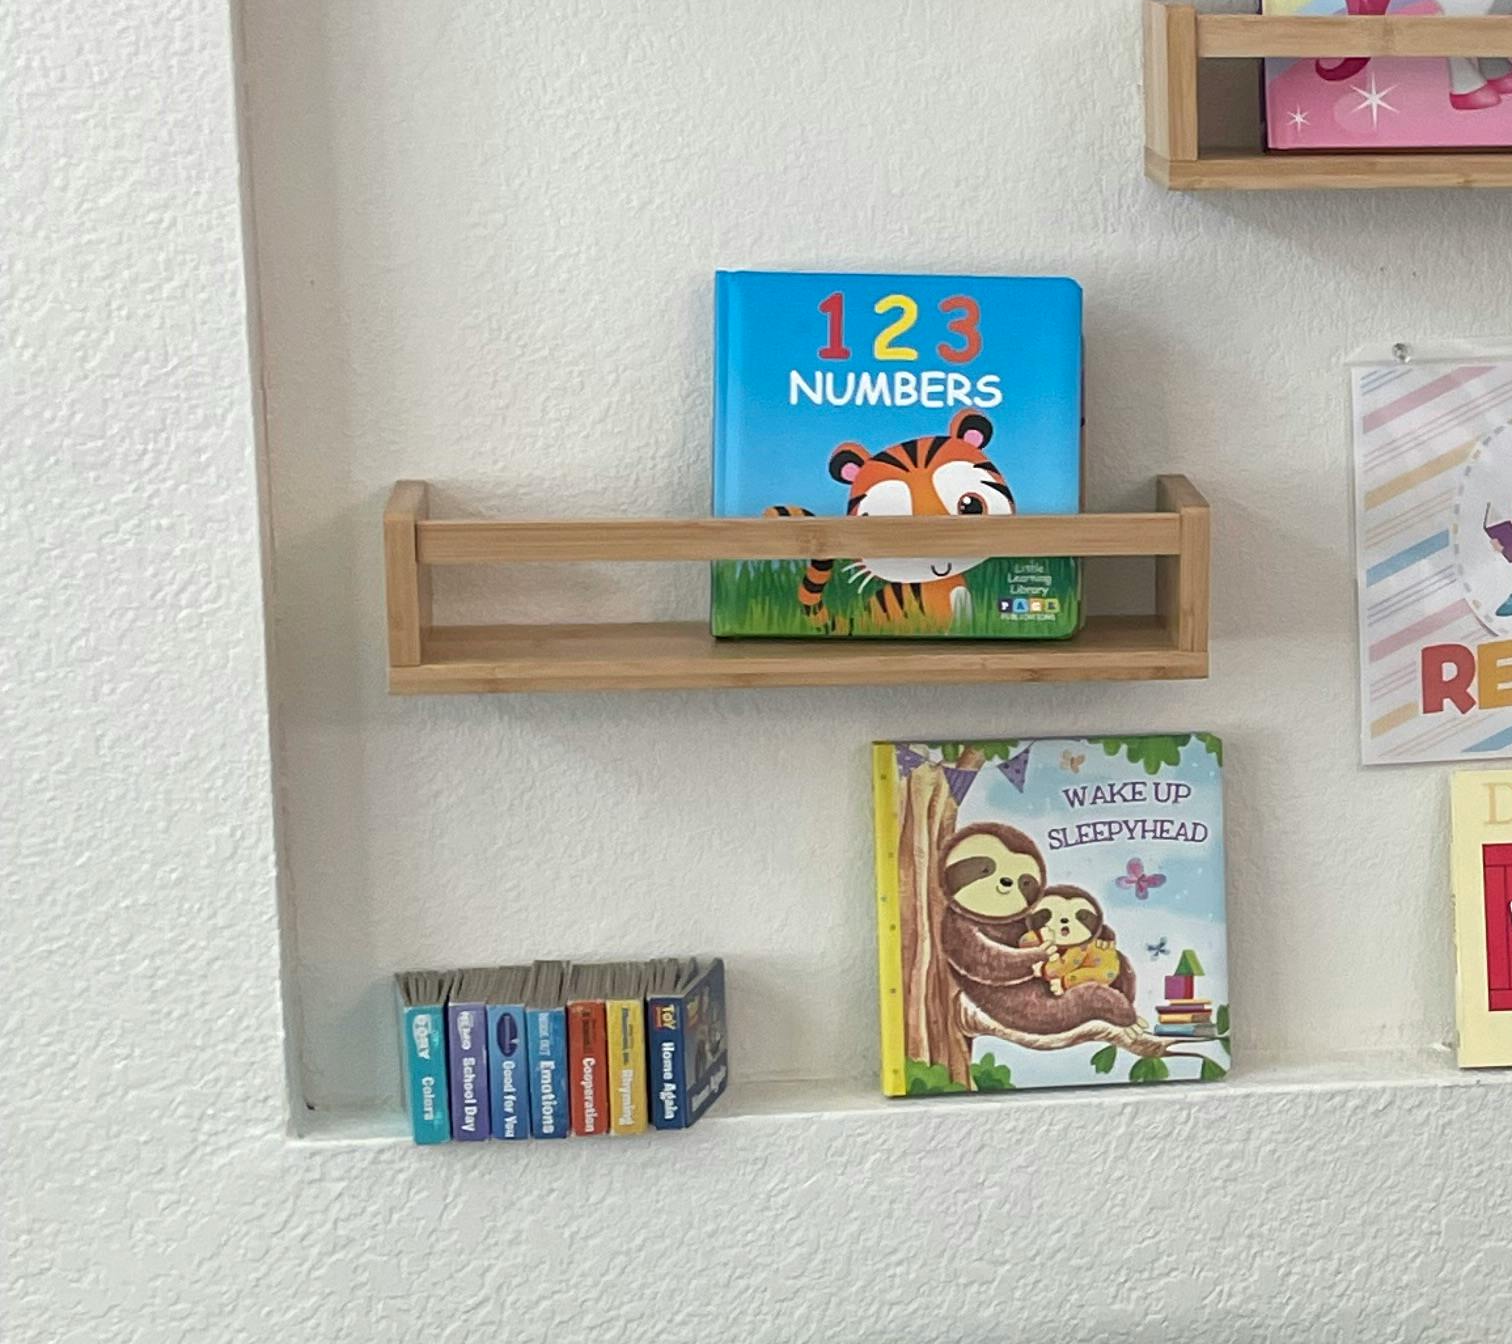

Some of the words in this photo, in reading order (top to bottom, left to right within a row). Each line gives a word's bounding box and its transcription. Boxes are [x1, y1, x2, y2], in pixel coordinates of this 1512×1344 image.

[817, 292, 851, 360] 1
[873, 294, 918, 361] 2
[936, 295, 983, 364] 3
[789, 370, 1003, 408] NUMBERS
[1062, 782, 1147, 809] WAKE
[1153, 782, 1192, 805] UP
[1048, 819, 1209, 850] SLEEPYHEAD
[462, 1057, 477, 1104] School
[502, 1061, 516, 1093] Good
[661, 1042, 676, 1081] Home
[421, 1076, 436, 1121] Colors
[503, 1093, 518, 1113] for
[539, 1060, 558, 1134] Emotions
[580, 1057, 598, 1132] Cooperation
[619, 1069, 635, 1125] Rhyming
[659, 1082, 679, 1120] Again
[461, 1106, 478, 1132] Day
[504, 1115, 518, 1138] You
